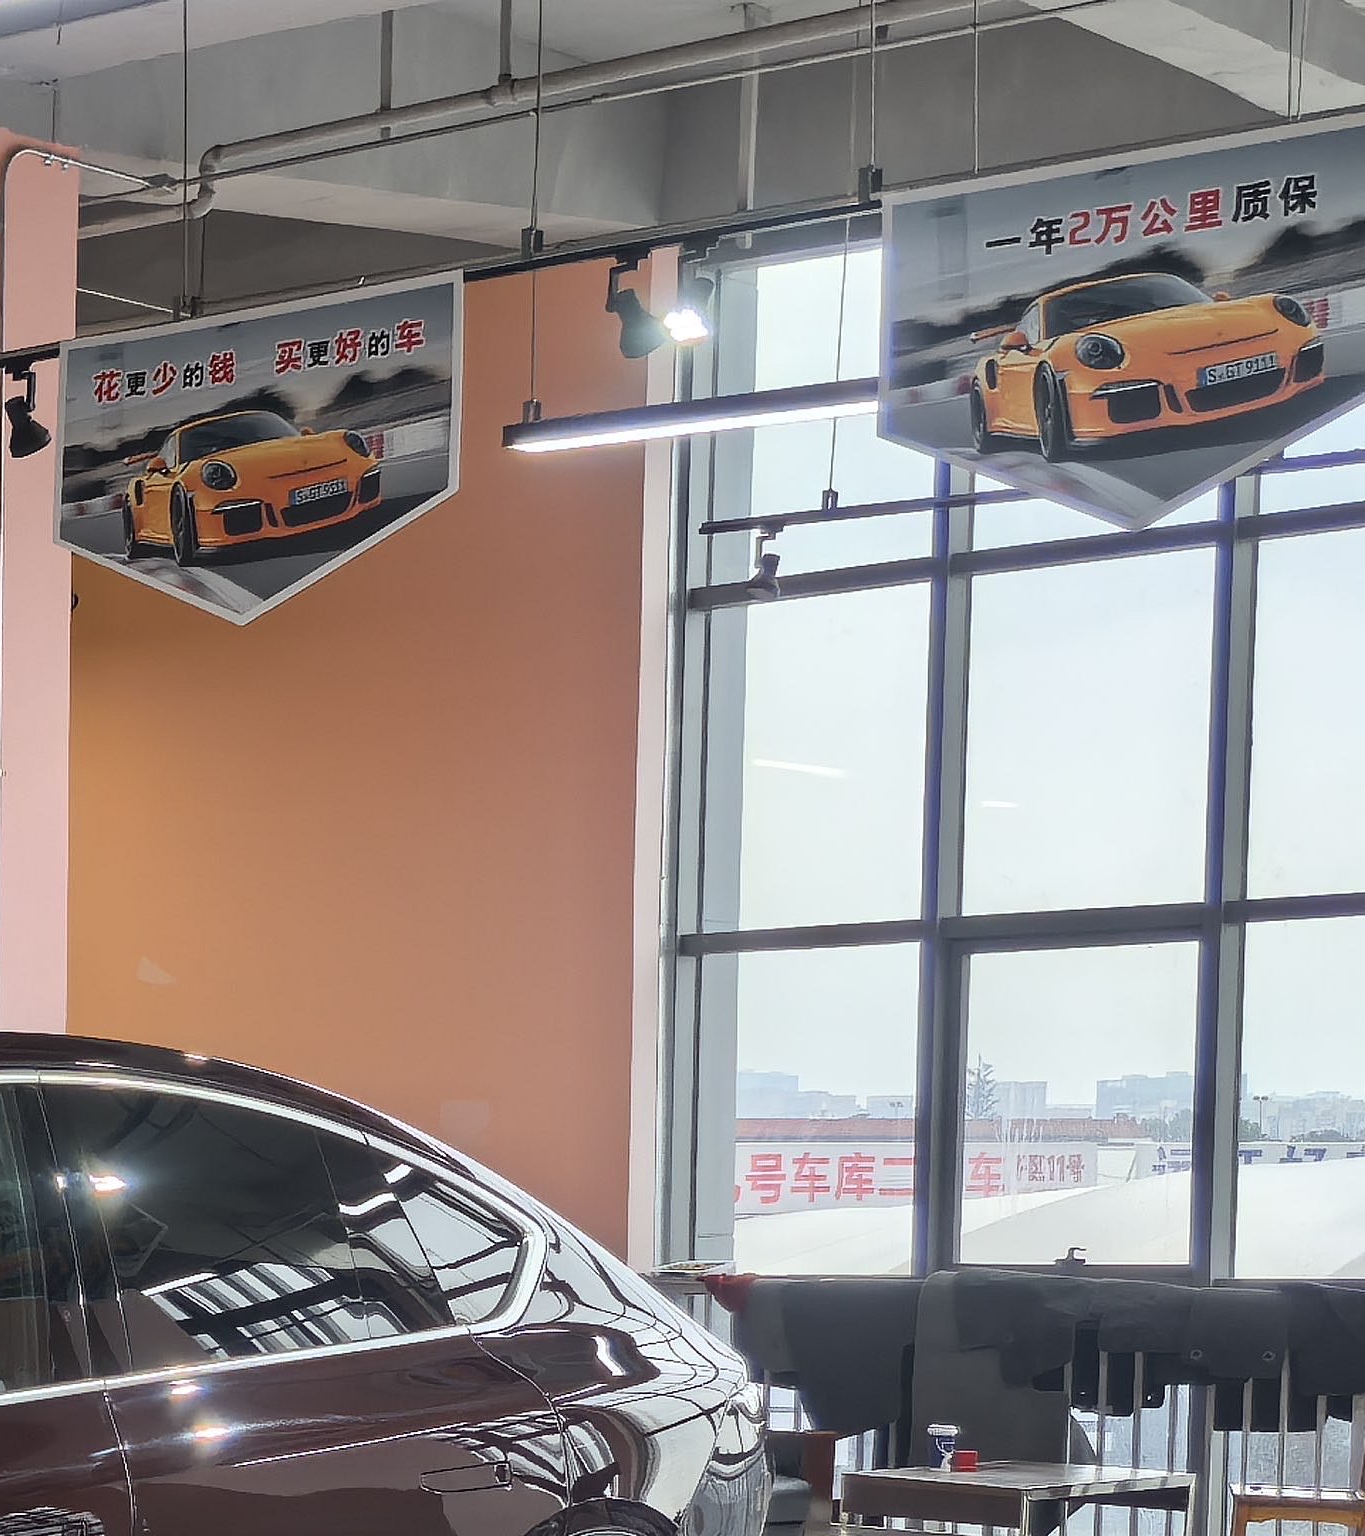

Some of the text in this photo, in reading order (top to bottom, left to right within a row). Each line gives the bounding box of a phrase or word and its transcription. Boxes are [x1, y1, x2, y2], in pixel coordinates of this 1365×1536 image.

[984, 174, 1317, 256] 一年2万公里质保
[93, 319, 425, 403] 花更少的钱 买更好的车
